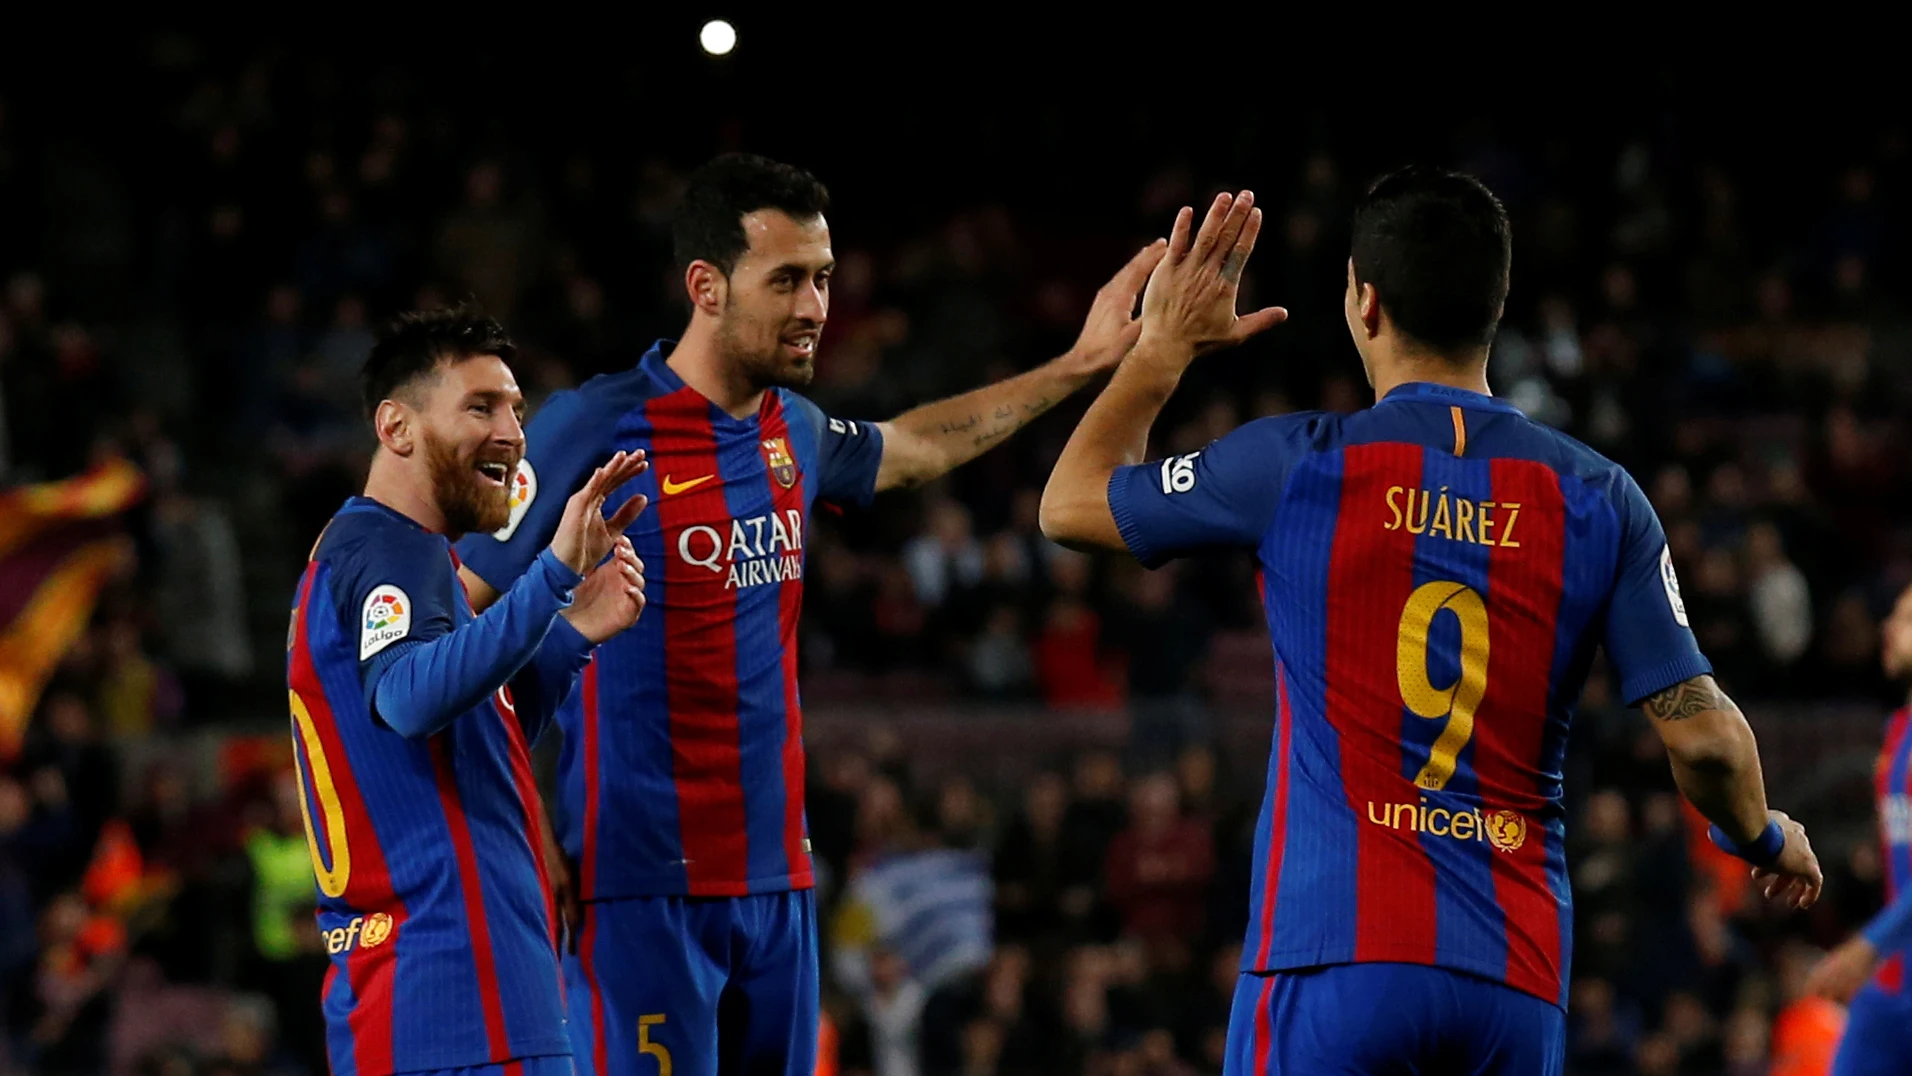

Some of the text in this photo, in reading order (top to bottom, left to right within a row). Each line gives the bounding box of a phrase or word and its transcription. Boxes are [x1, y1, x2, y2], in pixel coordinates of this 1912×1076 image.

[678, 509, 802, 573] QATAR
[1384, 486, 1521, 548] SUÁREZ
[1397, 580, 1490, 791] 9
[1368, 797, 1484, 842] unicef
[638, 1013, 672, 1076] 5
